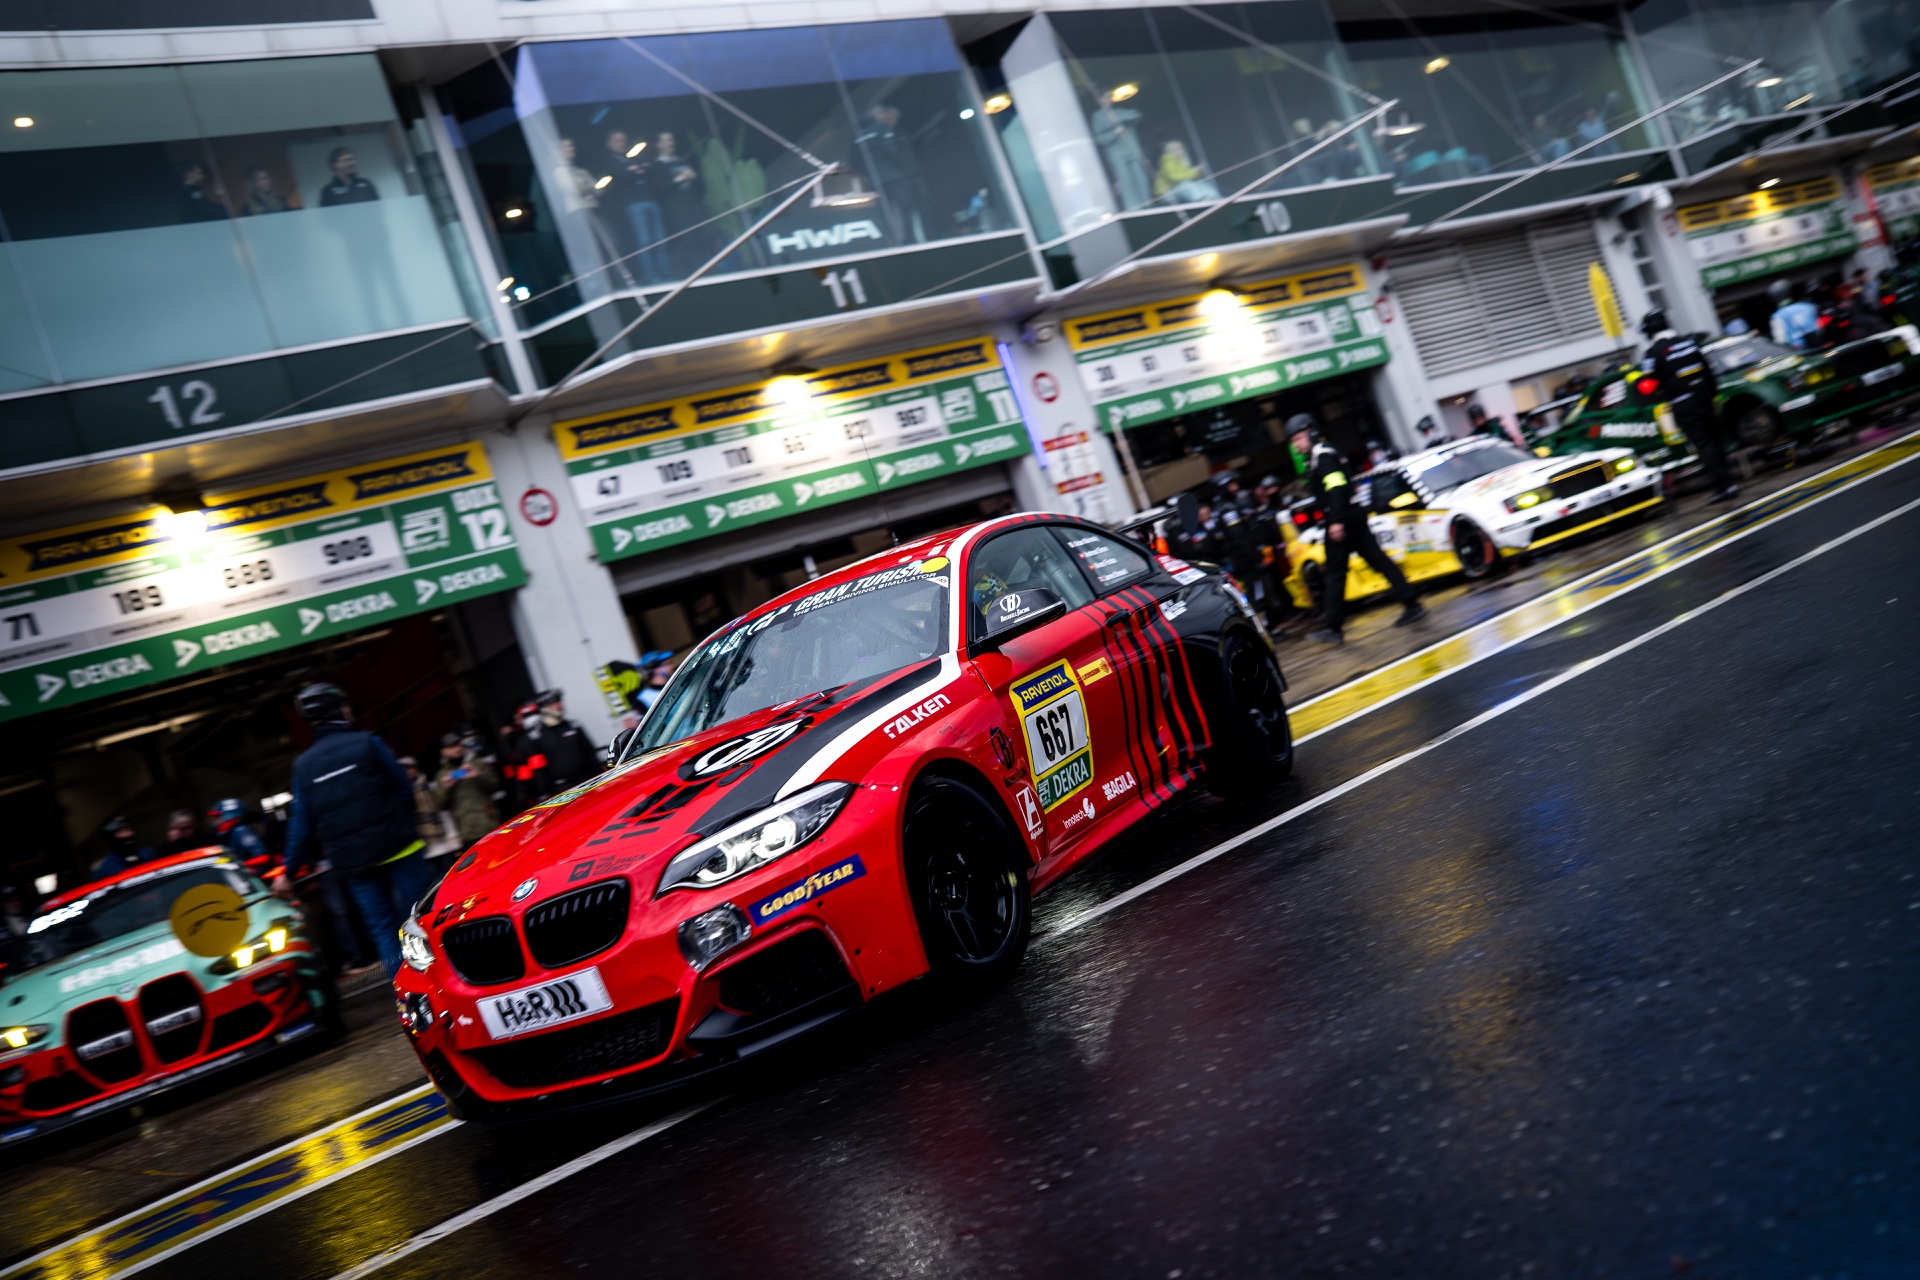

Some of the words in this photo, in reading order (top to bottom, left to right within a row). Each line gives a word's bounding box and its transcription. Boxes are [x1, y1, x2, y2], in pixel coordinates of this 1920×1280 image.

[767, 219, 883, 254] HWA
[1254, 200, 1292, 234] 10
[821, 268, 867, 308] 11
[148, 379, 225, 430] 12
[38, 517, 158, 561] RAVENO
[360, 461, 467, 491] RAVENOL
[450, 482, 500, 514] BOX
[459, 508, 513, 551] 12
[111, 585, 164, 615] 189
[792, 609, 809, 617] THE
[811, 599, 835, 610] REAL
[837, 586, 876, 602] DRIVING
[878, 572, 937, 589] SIMULATOR
[795, 582, 853, 612] GRAN
[852, 563, 925, 592] TURISM
[67, 653, 153, 689] DEKRA
[201, 621, 280, 655] DEKRA
[326, 591, 398, 624] DEKRA
[439, 563, 507, 594] DEKRA
[1021, 673, 1067, 702] RAVENOL
[883, 693, 952, 739] FALKEN
[1036, 703, 1074, 762] 667
[1052, 758, 1089, 798] DEKRA
[1109, 771, 1136, 796] AGILA
[760, 863, 854, 917] GOODYEAR
